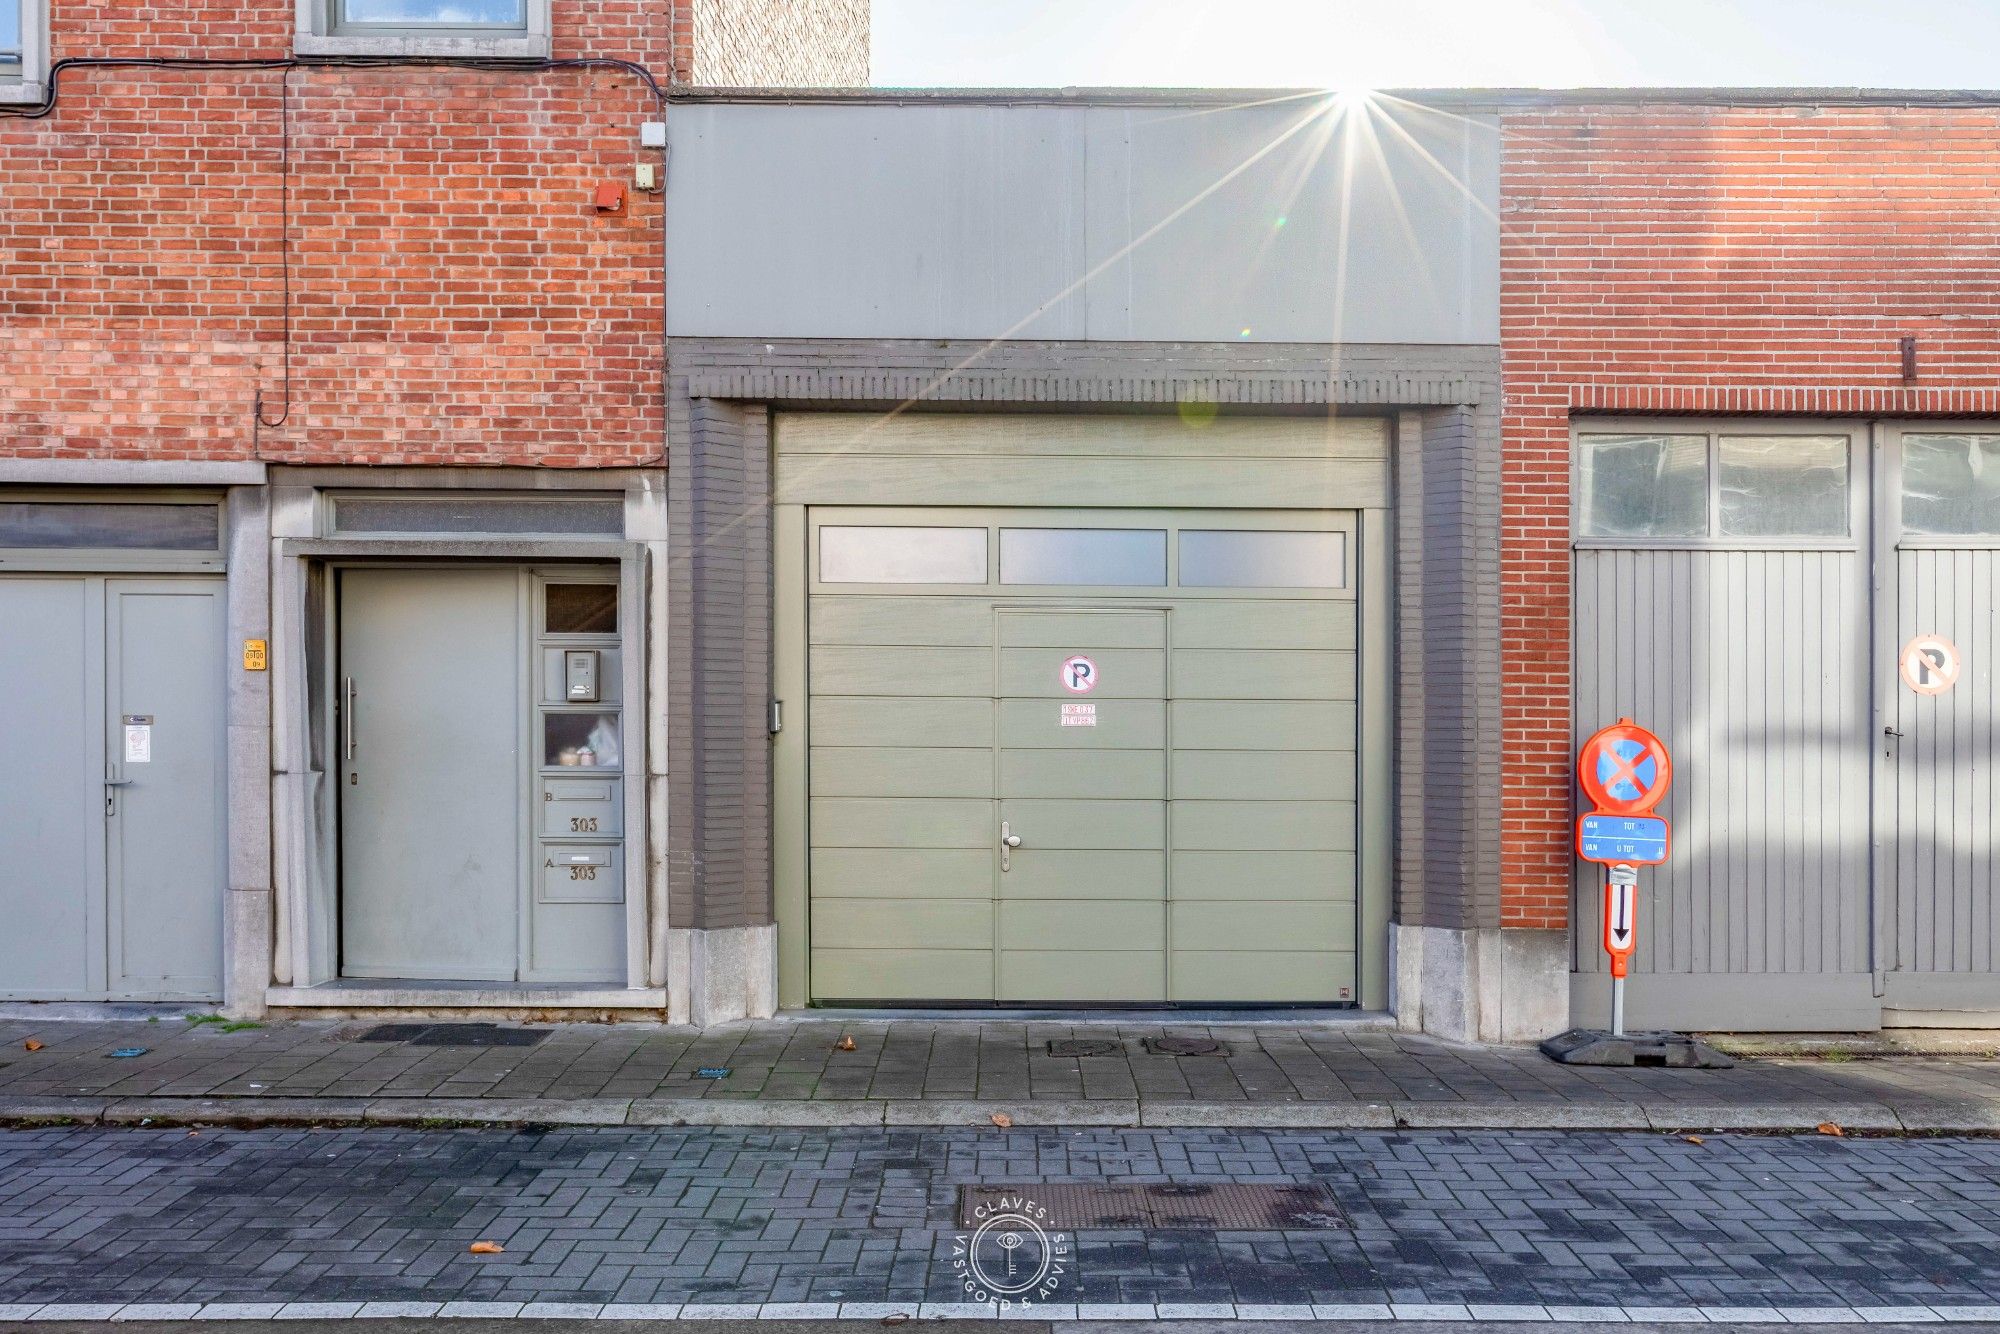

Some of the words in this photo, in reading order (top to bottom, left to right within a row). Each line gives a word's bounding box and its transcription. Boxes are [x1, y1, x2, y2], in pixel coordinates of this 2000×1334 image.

[544, 792, 553, 801] B
[569, 817, 598, 832] 303
[1585, 821, 1598, 829] VAN
[1624, 822, 1635, 830] TOT
[1585, 843, 1598, 851] VAN
[1616, 845, 1622, 853] U
[1623, 845, 1635, 853] TOT
[545, 858, 555, 867] A
[569, 865, 596, 880] 303
